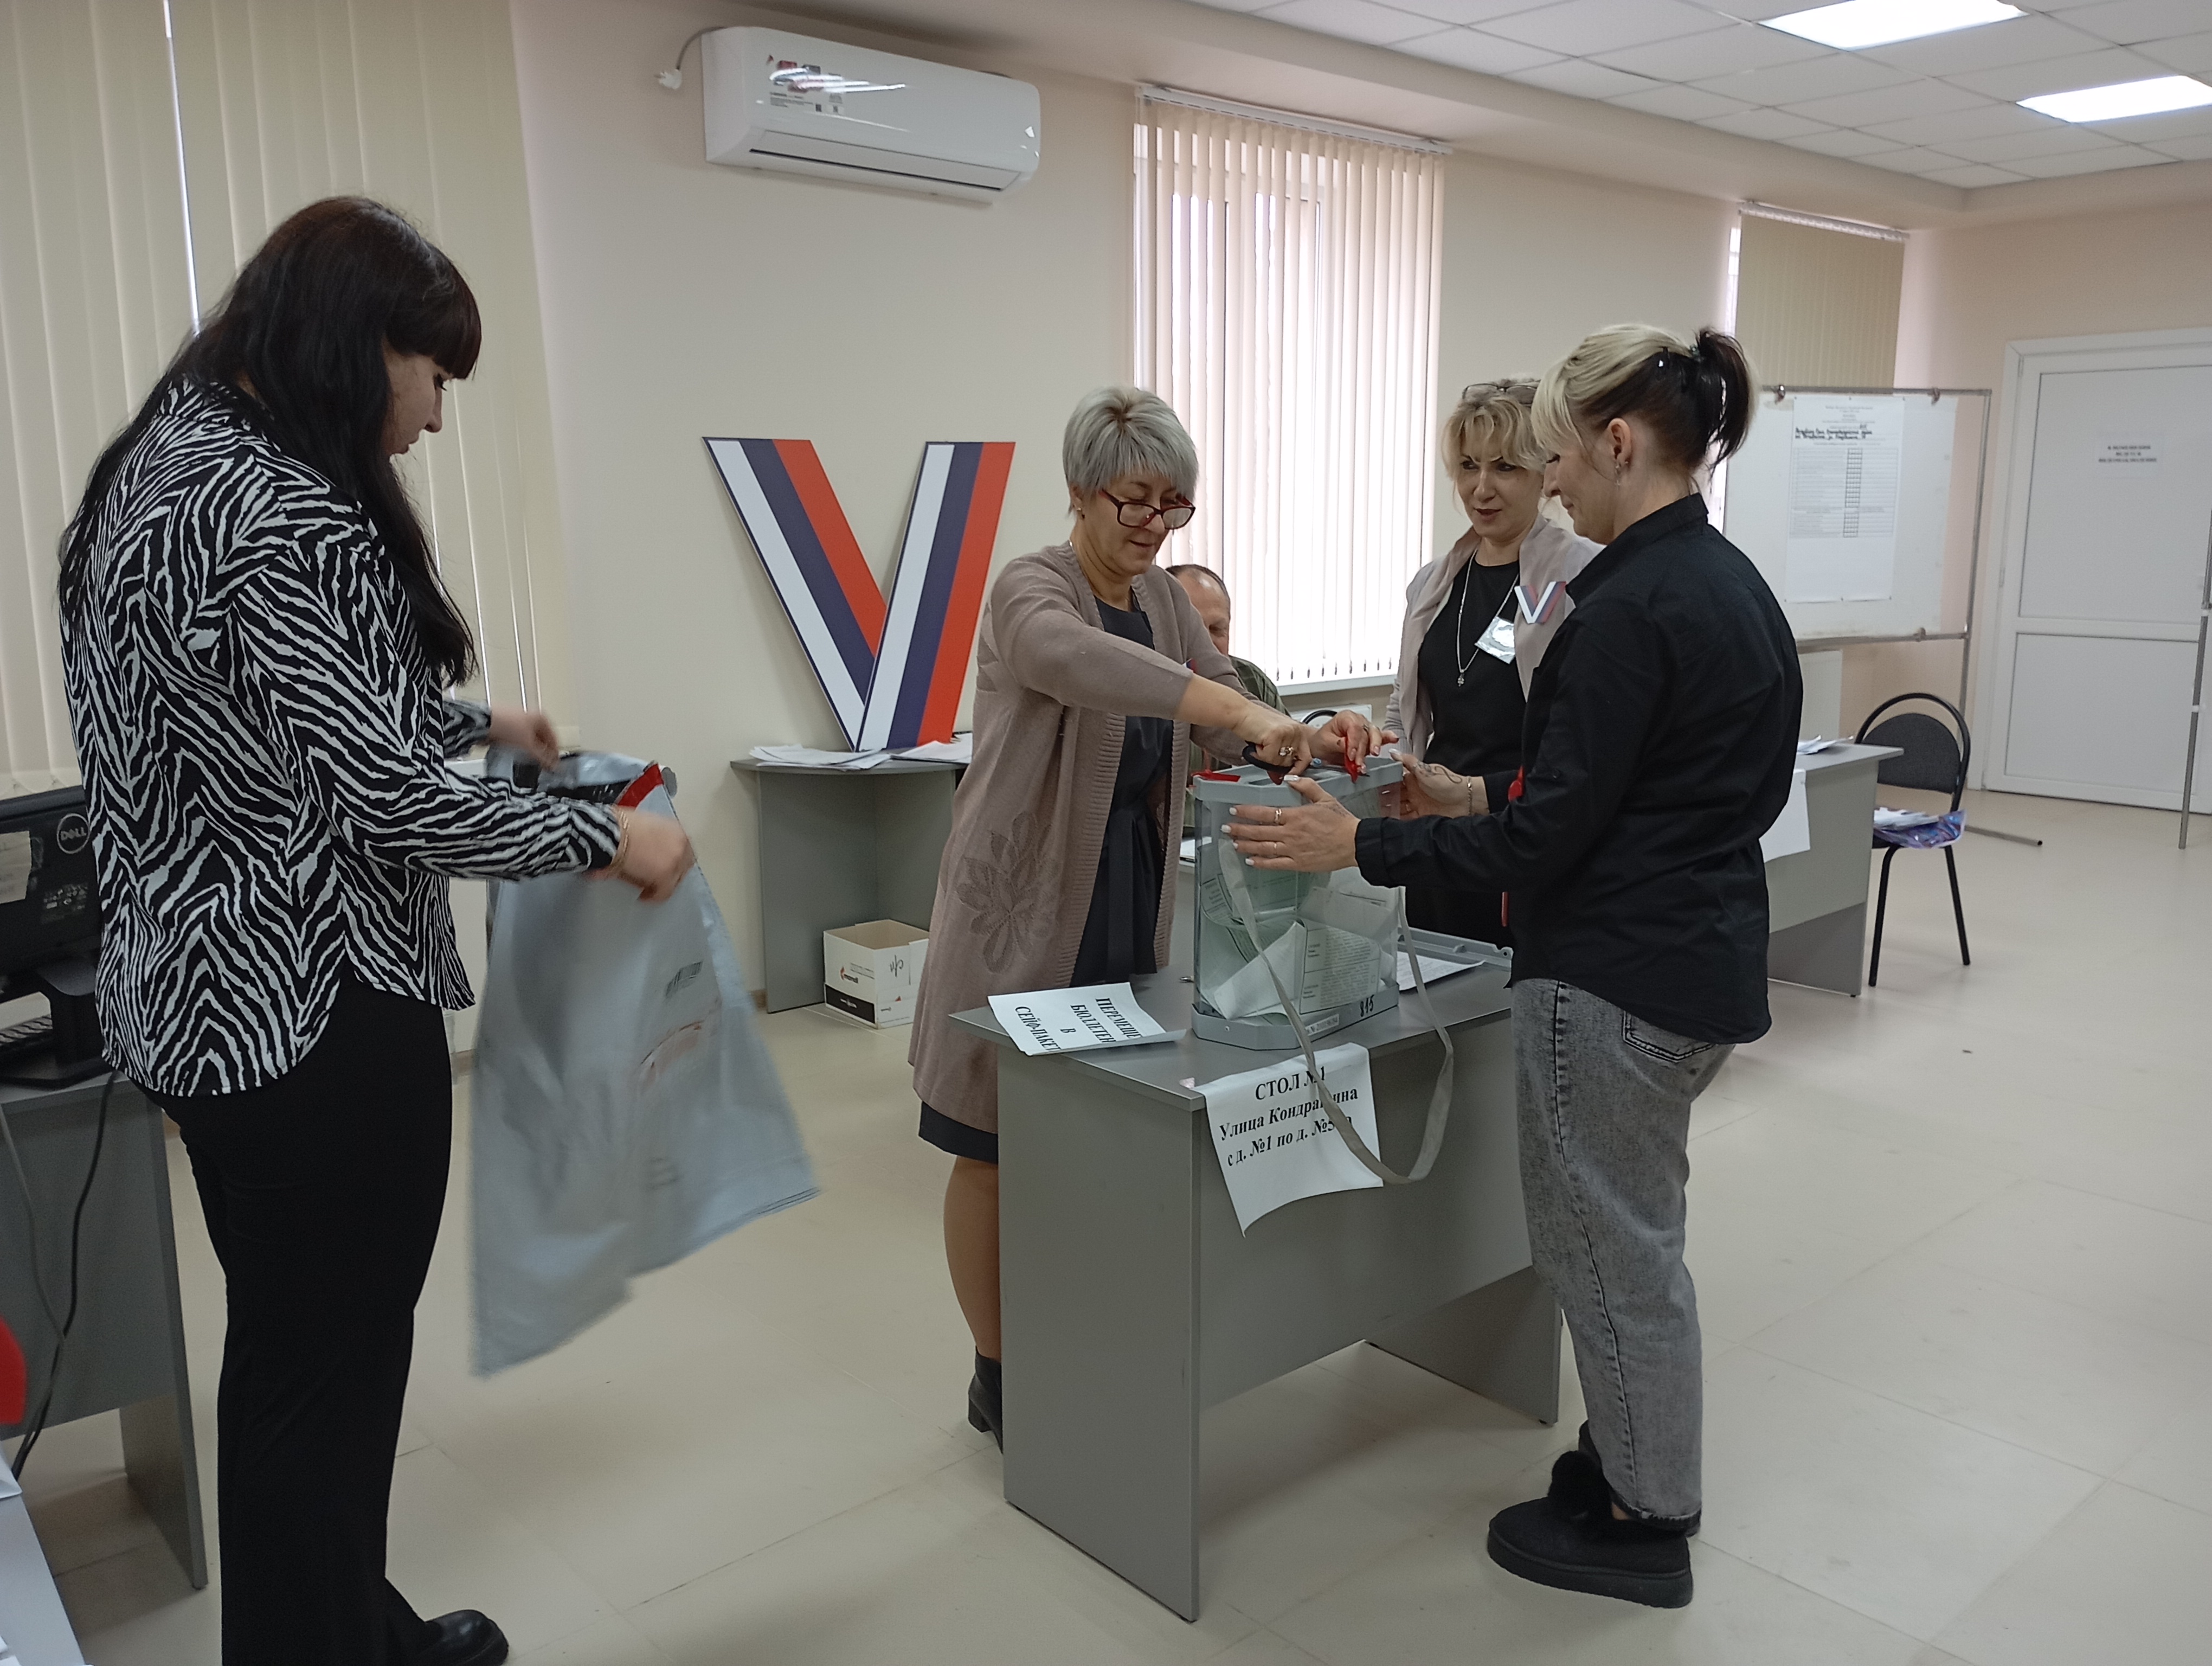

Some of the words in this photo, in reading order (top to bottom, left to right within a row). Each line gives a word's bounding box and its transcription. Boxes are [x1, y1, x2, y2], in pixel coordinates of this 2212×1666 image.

[60, 826, 87, 841] DELL
[1360, 994, 1375, 1017] 815
[1255, 1073, 1300, 1100] СТОЛ
[1219, 1115, 1264, 1141] Улица
[1268, 1088, 1358, 1125] Кондраина
[1227, 1154, 1233, 1167] с
[1236, 1150, 1246, 1165] д.
[1249, 1135, 1272, 1157] №1
[1277, 1132, 1294, 1148] по
[1296, 1129, 1308, 1143] д.
